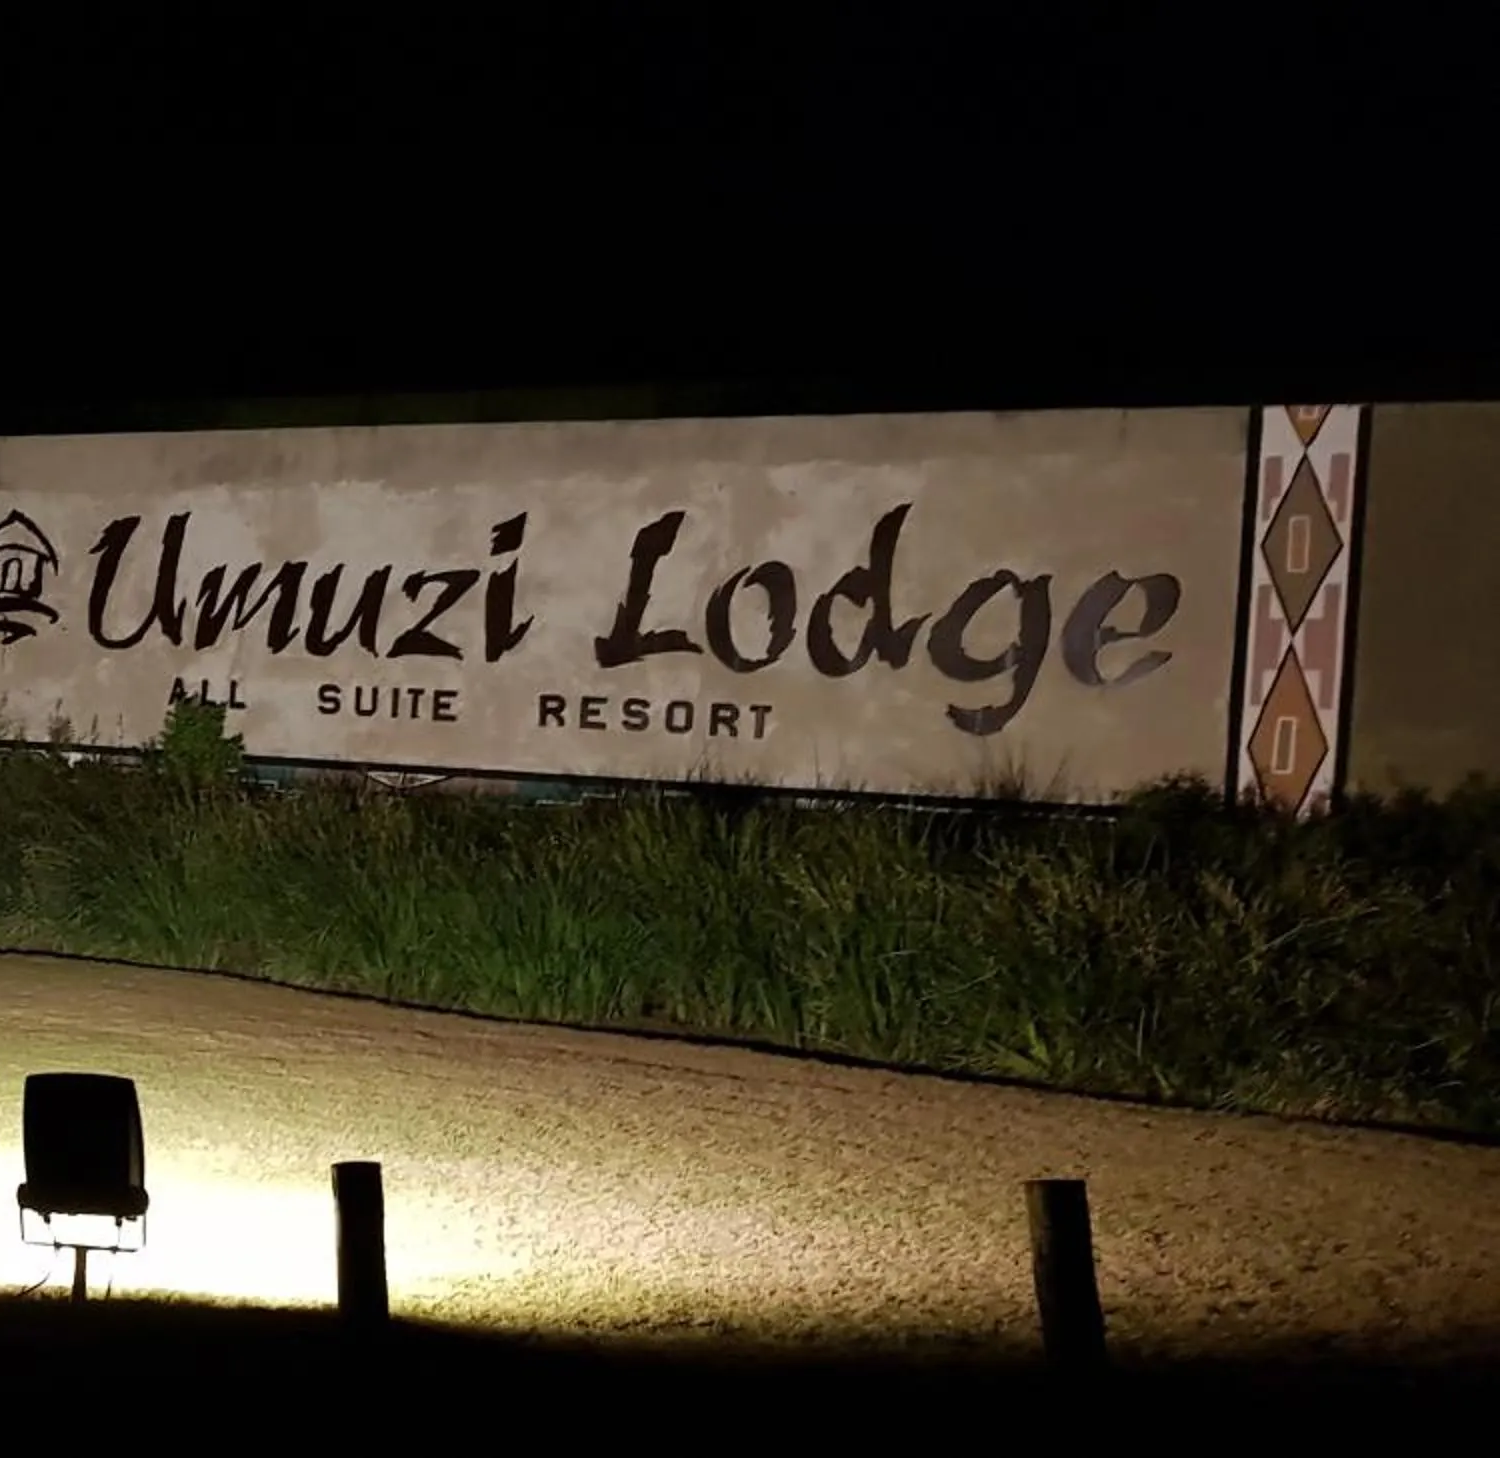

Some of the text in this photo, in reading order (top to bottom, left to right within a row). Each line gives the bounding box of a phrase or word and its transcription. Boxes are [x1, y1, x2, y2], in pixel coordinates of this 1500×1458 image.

[88, 502, 1182, 735] Umuzi Lodge
[168, 677, 773, 740] ALL SUITE RESORT
